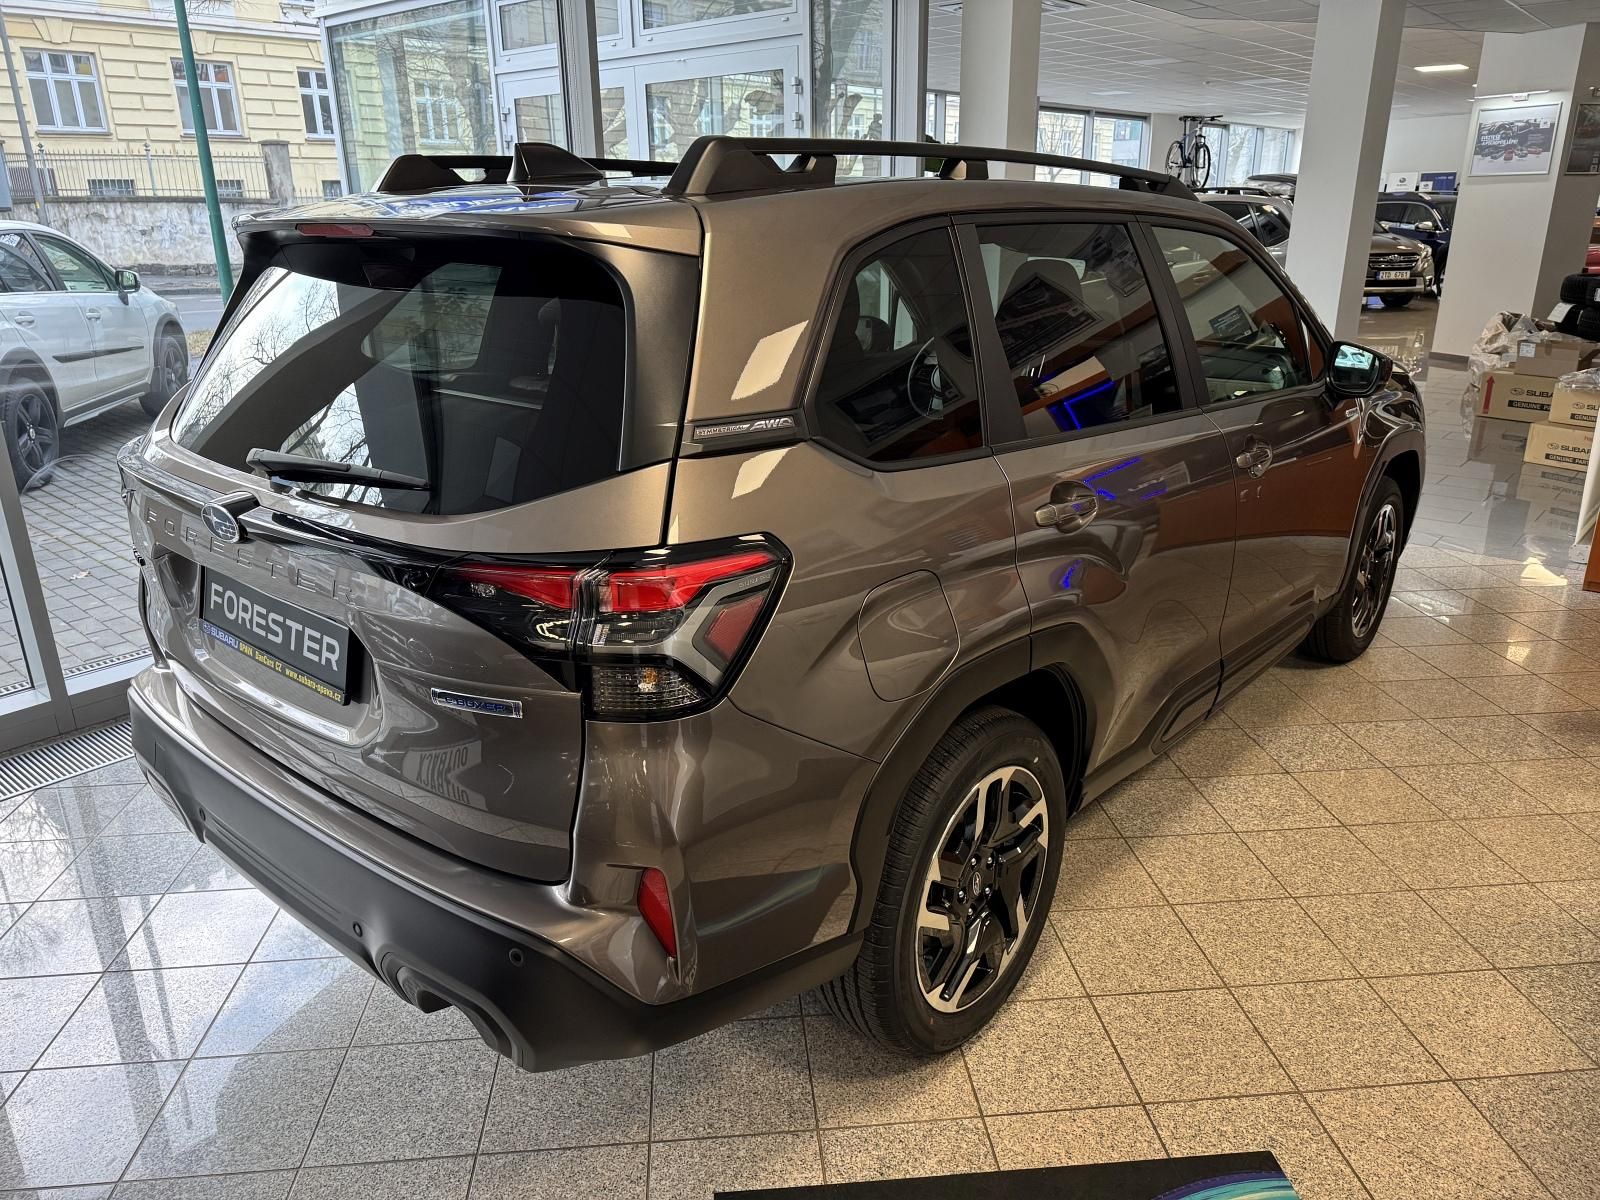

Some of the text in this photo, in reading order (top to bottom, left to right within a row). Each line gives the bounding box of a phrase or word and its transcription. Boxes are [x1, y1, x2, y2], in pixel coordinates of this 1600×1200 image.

[1513, 401, 1541, 410] GENUINE
[750, 417, 793, 431] AWD
[1549, 454, 1575, 463] GENUINE
[146, 507, 359, 609] FORESTER
[210, 582, 340, 671] FORESTER
[210, 624, 239, 649] SUBARU
